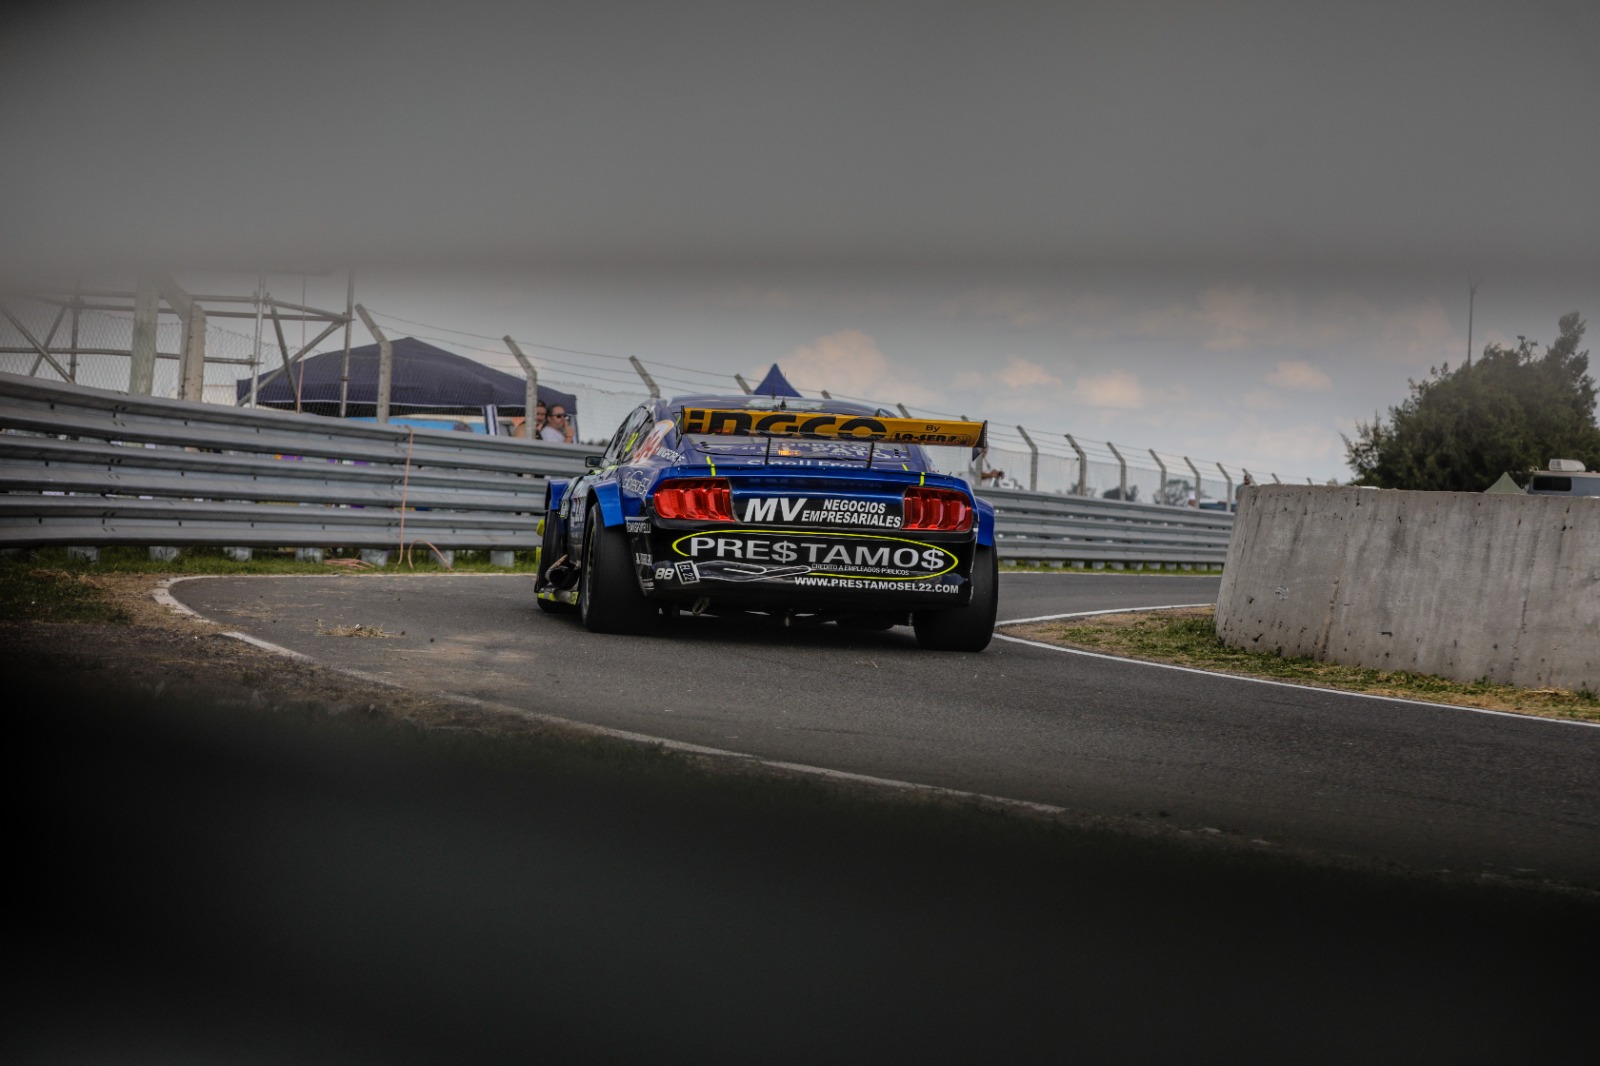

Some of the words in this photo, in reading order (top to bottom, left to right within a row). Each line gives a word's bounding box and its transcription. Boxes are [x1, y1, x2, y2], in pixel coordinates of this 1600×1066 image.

[925, 424, 941, 432] By
[743, 498, 807, 522] MV
[823, 499, 886, 514] NEGOCIOS
[801, 510, 901, 528] EMPRESARIALES
[654, 567, 675, 581] 88
[794, 576, 959, 594] WWW.PRESTAMOSEL22.COM
